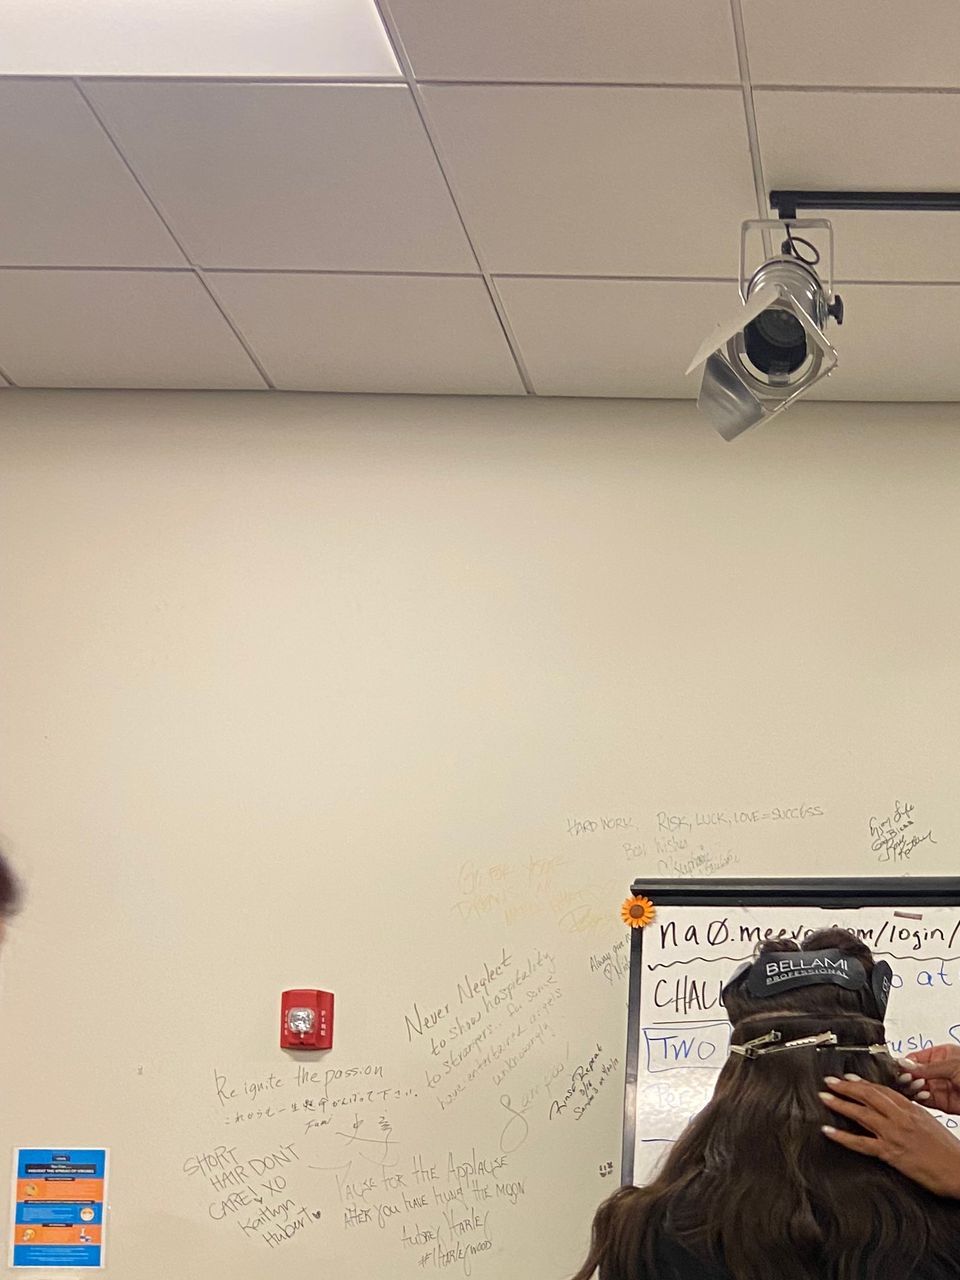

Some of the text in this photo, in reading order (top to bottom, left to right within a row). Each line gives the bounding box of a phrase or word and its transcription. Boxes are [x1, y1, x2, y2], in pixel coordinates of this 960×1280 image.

[765, 957, 849, 976] BELLAMI
[916, 960, 952, 986] at
[404, 948, 512, 1042] Never Neglect
[650, 1036, 716, 1061] TWO
[297, 1065, 319, 1087] the
[323, 1065, 384, 1100] passion
[183, 1145, 238, 1177] SHORT
[209, 1142, 301, 1193] HAIR DON'T
[260, 1175, 287, 1197] XO
